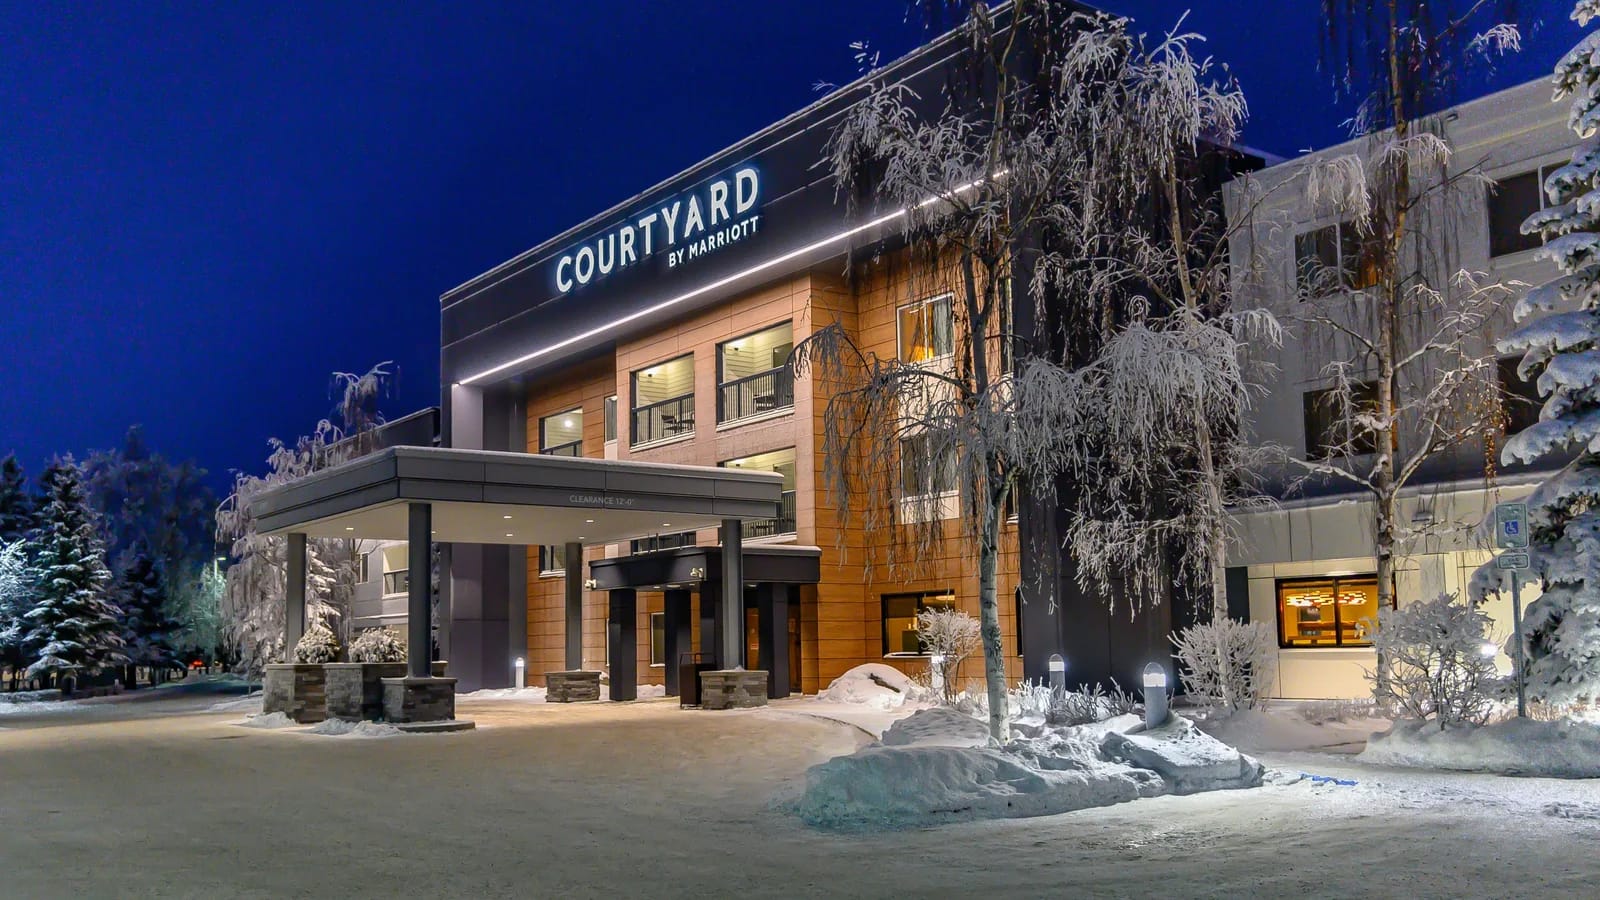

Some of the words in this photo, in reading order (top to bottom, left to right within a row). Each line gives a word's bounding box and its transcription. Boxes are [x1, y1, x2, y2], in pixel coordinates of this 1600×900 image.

[556, 168, 759, 293] COURTYARD
[668, 248, 685, 268] BY
[689, 215, 759, 260] MARRIOTT
[569, 494, 614, 505] CLEARANCE
